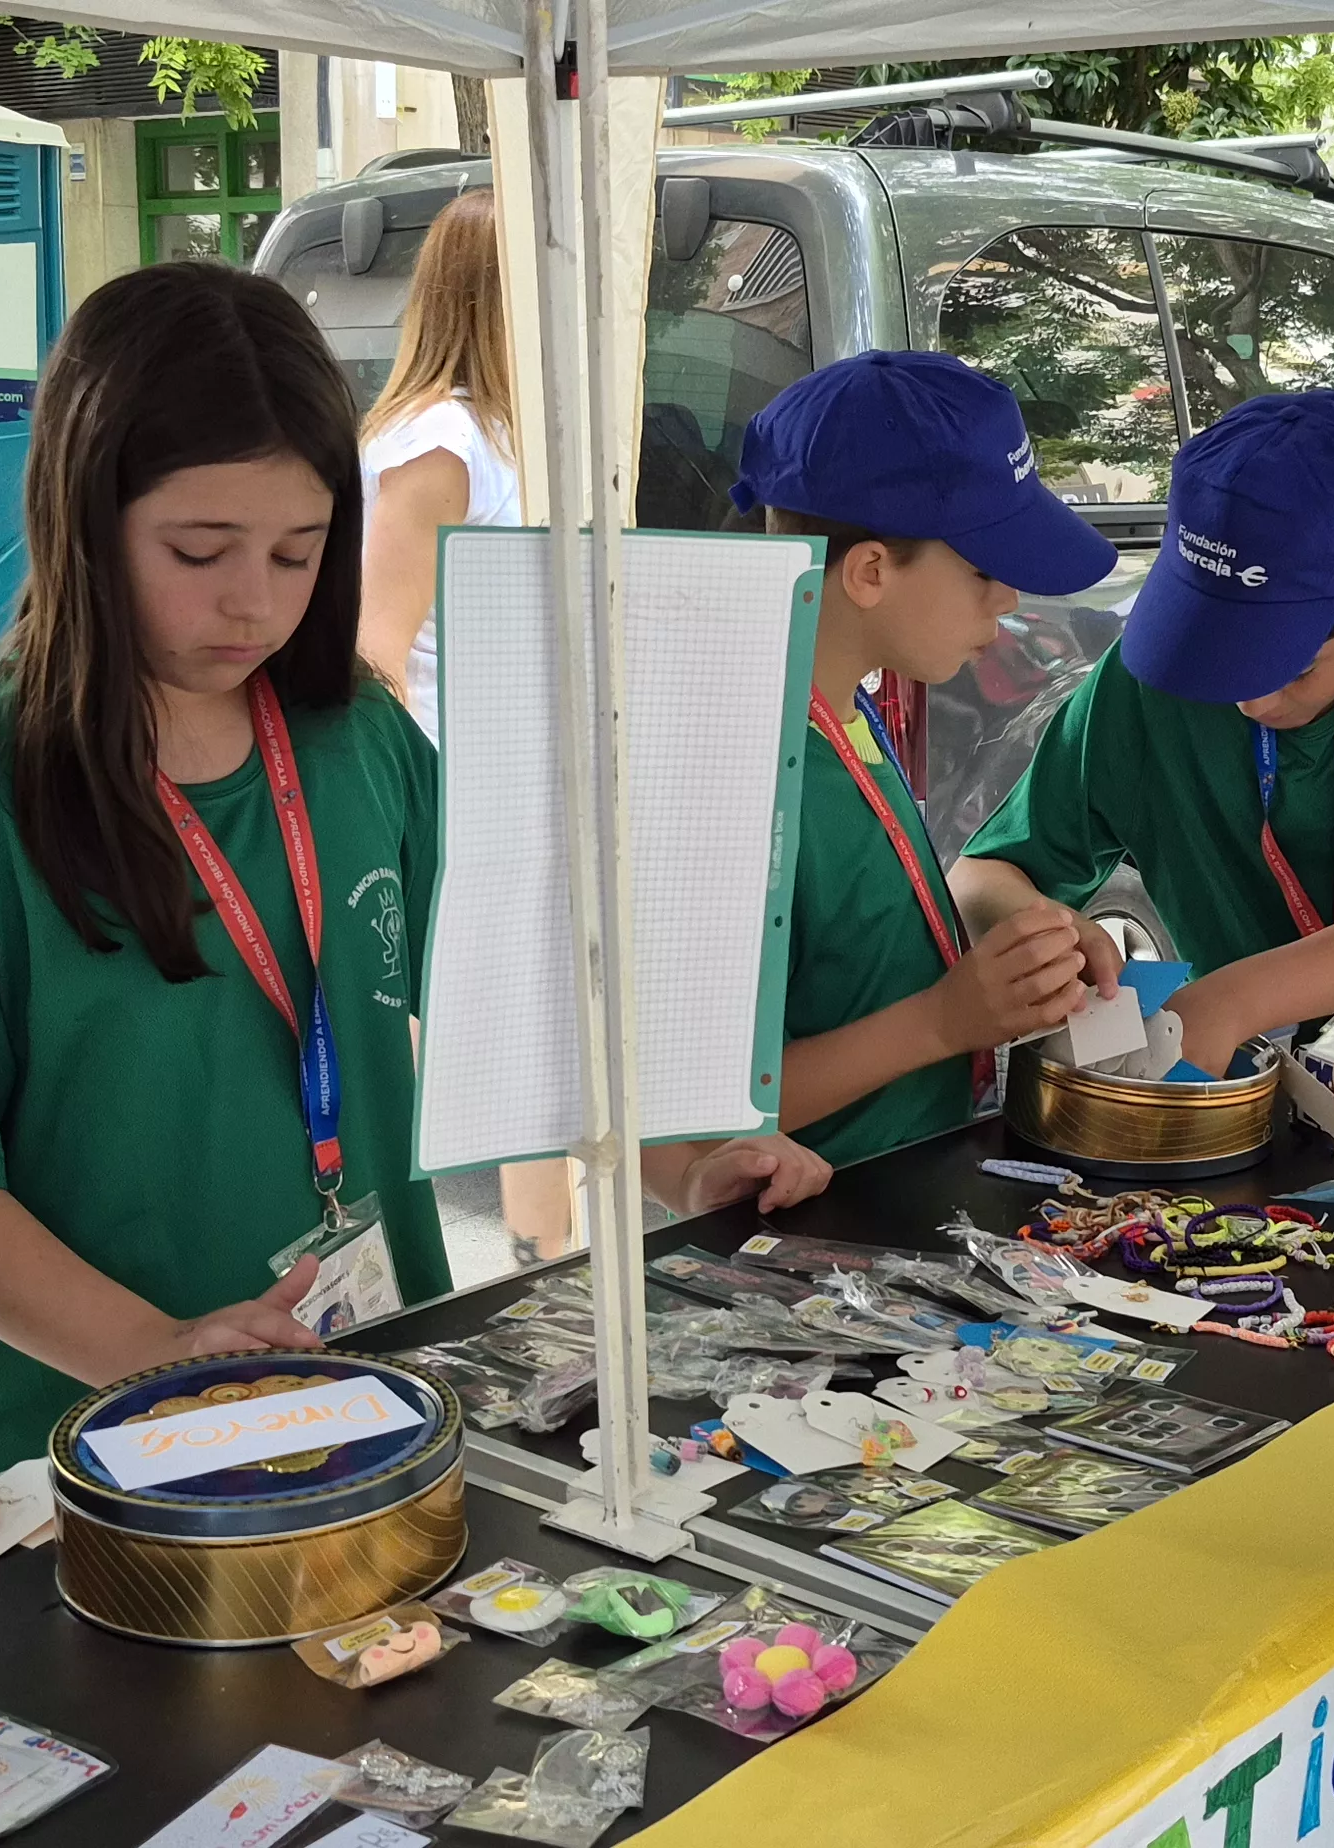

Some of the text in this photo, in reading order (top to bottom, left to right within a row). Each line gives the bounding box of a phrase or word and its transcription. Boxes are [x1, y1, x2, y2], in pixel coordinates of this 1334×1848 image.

[1178, 524, 1237, 558] Fundación
[1178, 539, 1232, 578] Ibercaja
[268, 738, 288, 787] IBERCAJA
[192, 832, 226, 881] IBERCAJA
[286, 810, 310, 887] APRENDIENDO
[219, 881, 259, 945] FUNDACIÓN
[347, 869, 379, 909] SANCHO
[1273, 861, 1304, 910] EMPRENDER
[1298, 908, 1313, 927] CON
[251, 941, 270, 967] CON
[317, 1037, 330, 1116] APRENDIENDO
